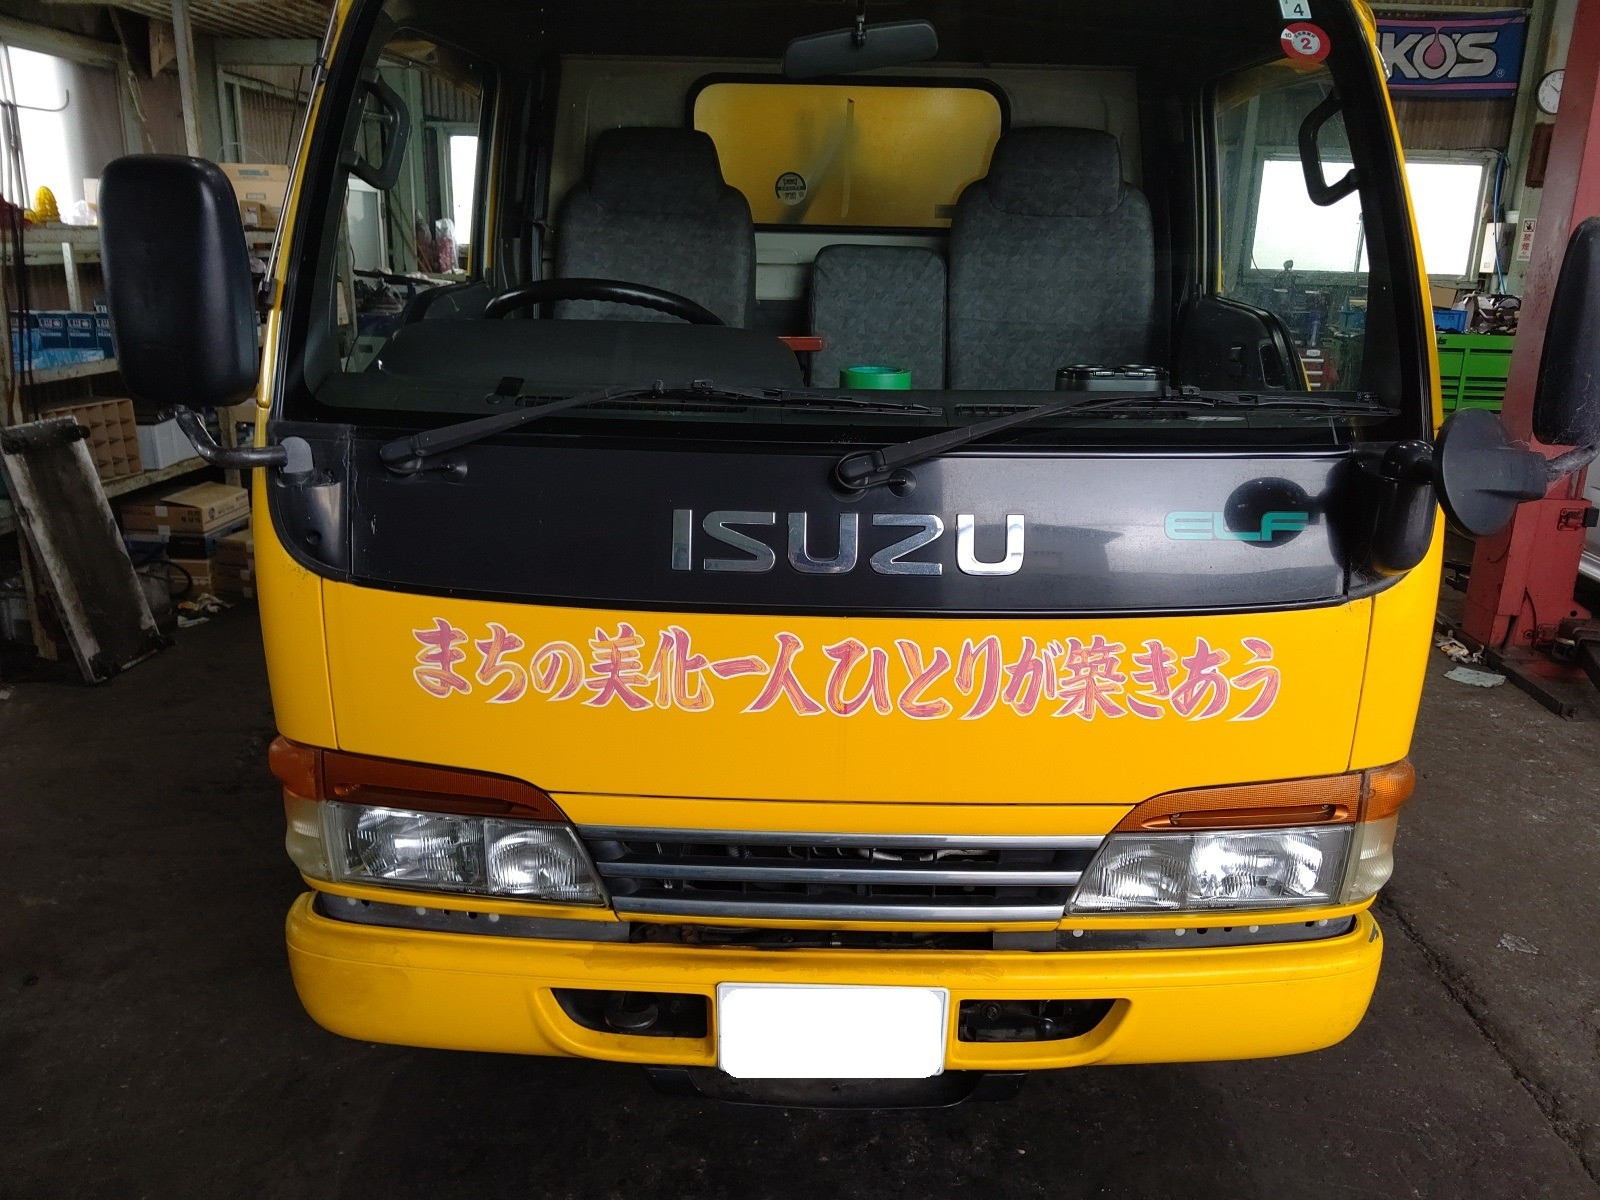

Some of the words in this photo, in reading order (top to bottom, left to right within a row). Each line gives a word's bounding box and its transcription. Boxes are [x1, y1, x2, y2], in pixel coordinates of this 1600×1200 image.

[1293, 3, 1304, 16] 4
[1300, 37, 1312, 50] 2
[1377, 31, 1498, 80] KO'S
[671, 508, 1025, 577] ISUZU
[1164, 510, 1309, 542] ELF
[410, 616, 1282, 722] まちの美化一人ひとりが築きあう
